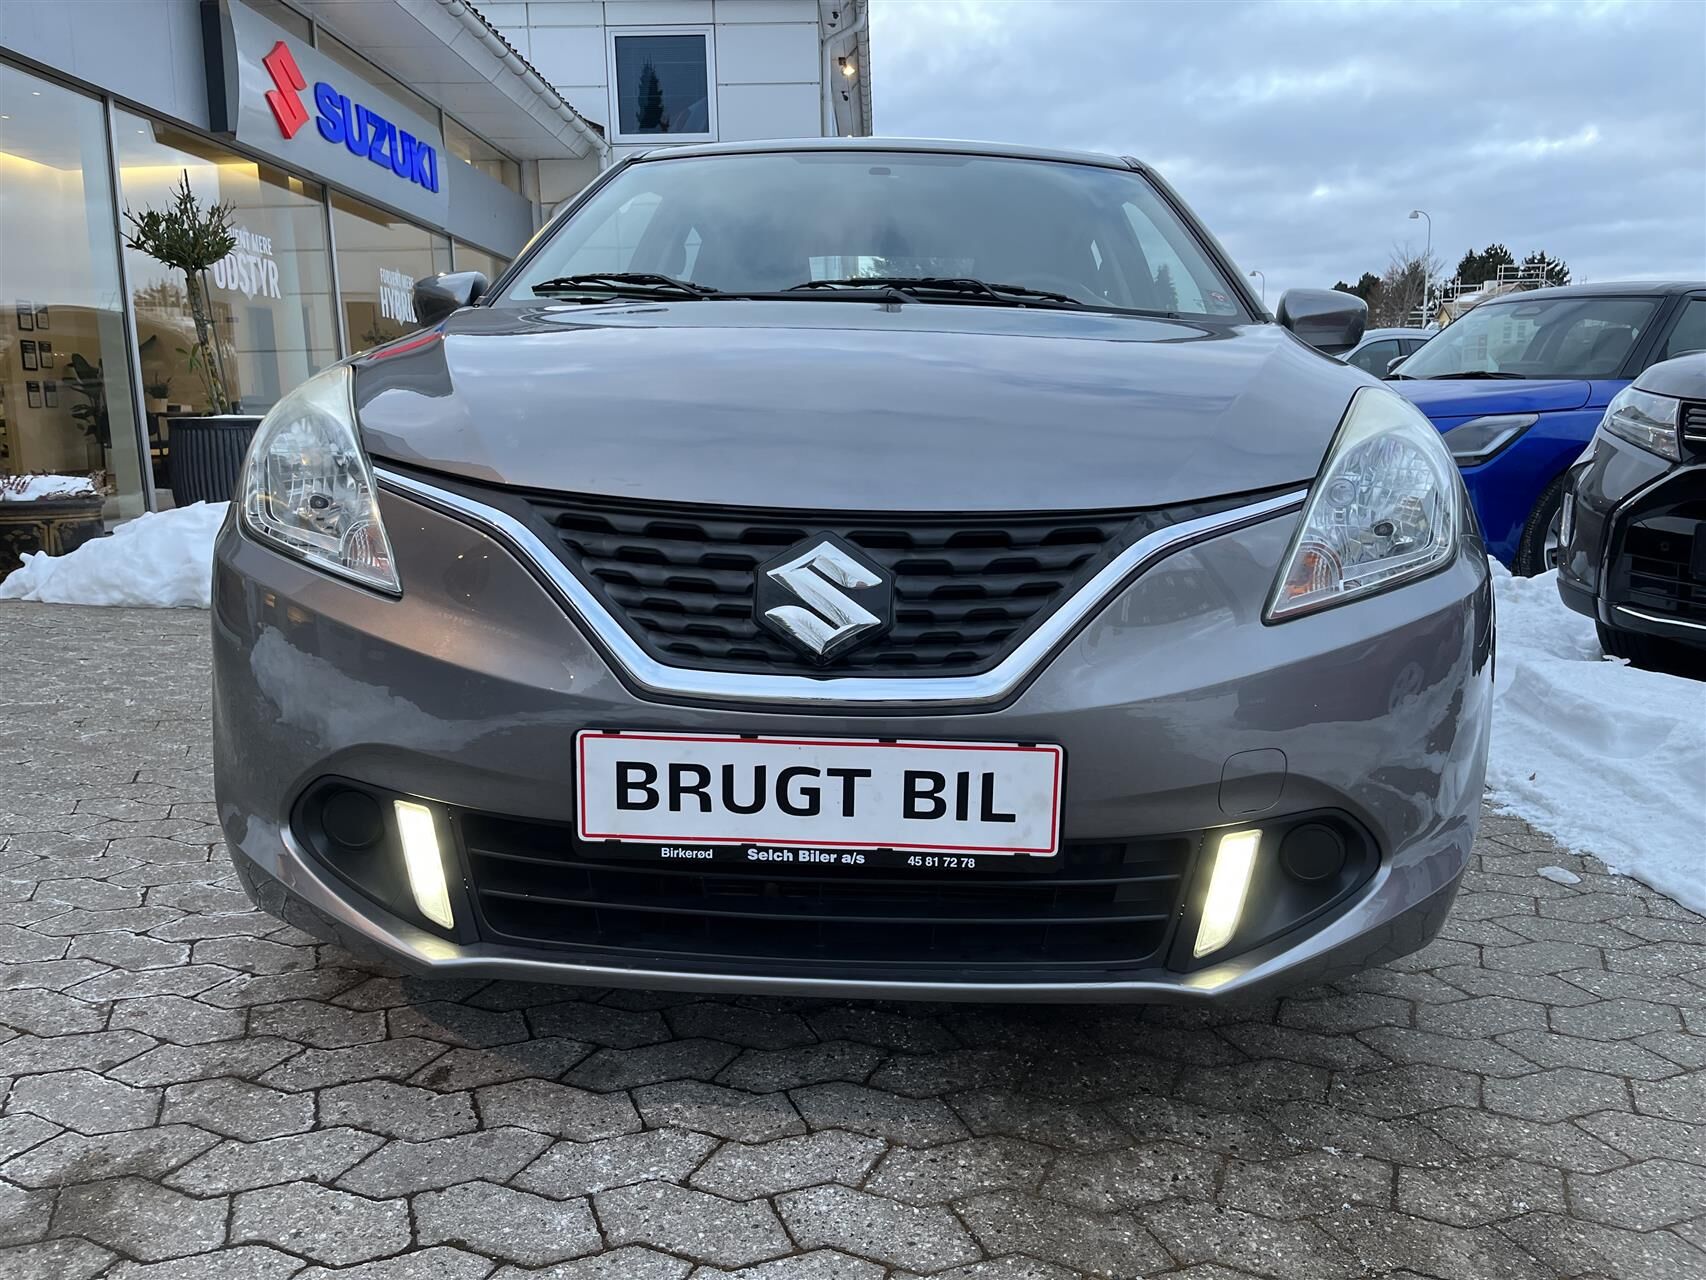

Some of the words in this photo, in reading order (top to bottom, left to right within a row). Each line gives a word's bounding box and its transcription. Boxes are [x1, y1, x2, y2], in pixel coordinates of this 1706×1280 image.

[314, 82, 439, 193] SUZUKI
[251, 233, 273, 256] MERE
[213, 253, 282, 299] UDSTYR
[615, 760, 872, 818] BRUGT
[902, 769, 1017, 823] BIL
[661, 847, 713, 859] Birkerød
[747, 848, 794, 862] Selch
[798, 850, 837, 863] Biler
[841, 852, 866, 864] a/s
[907, 855, 922, 866] 45
[925, 856, 939, 867] 81
[943, 857, 958, 868] 72
[960, 857, 976, 869] 78
